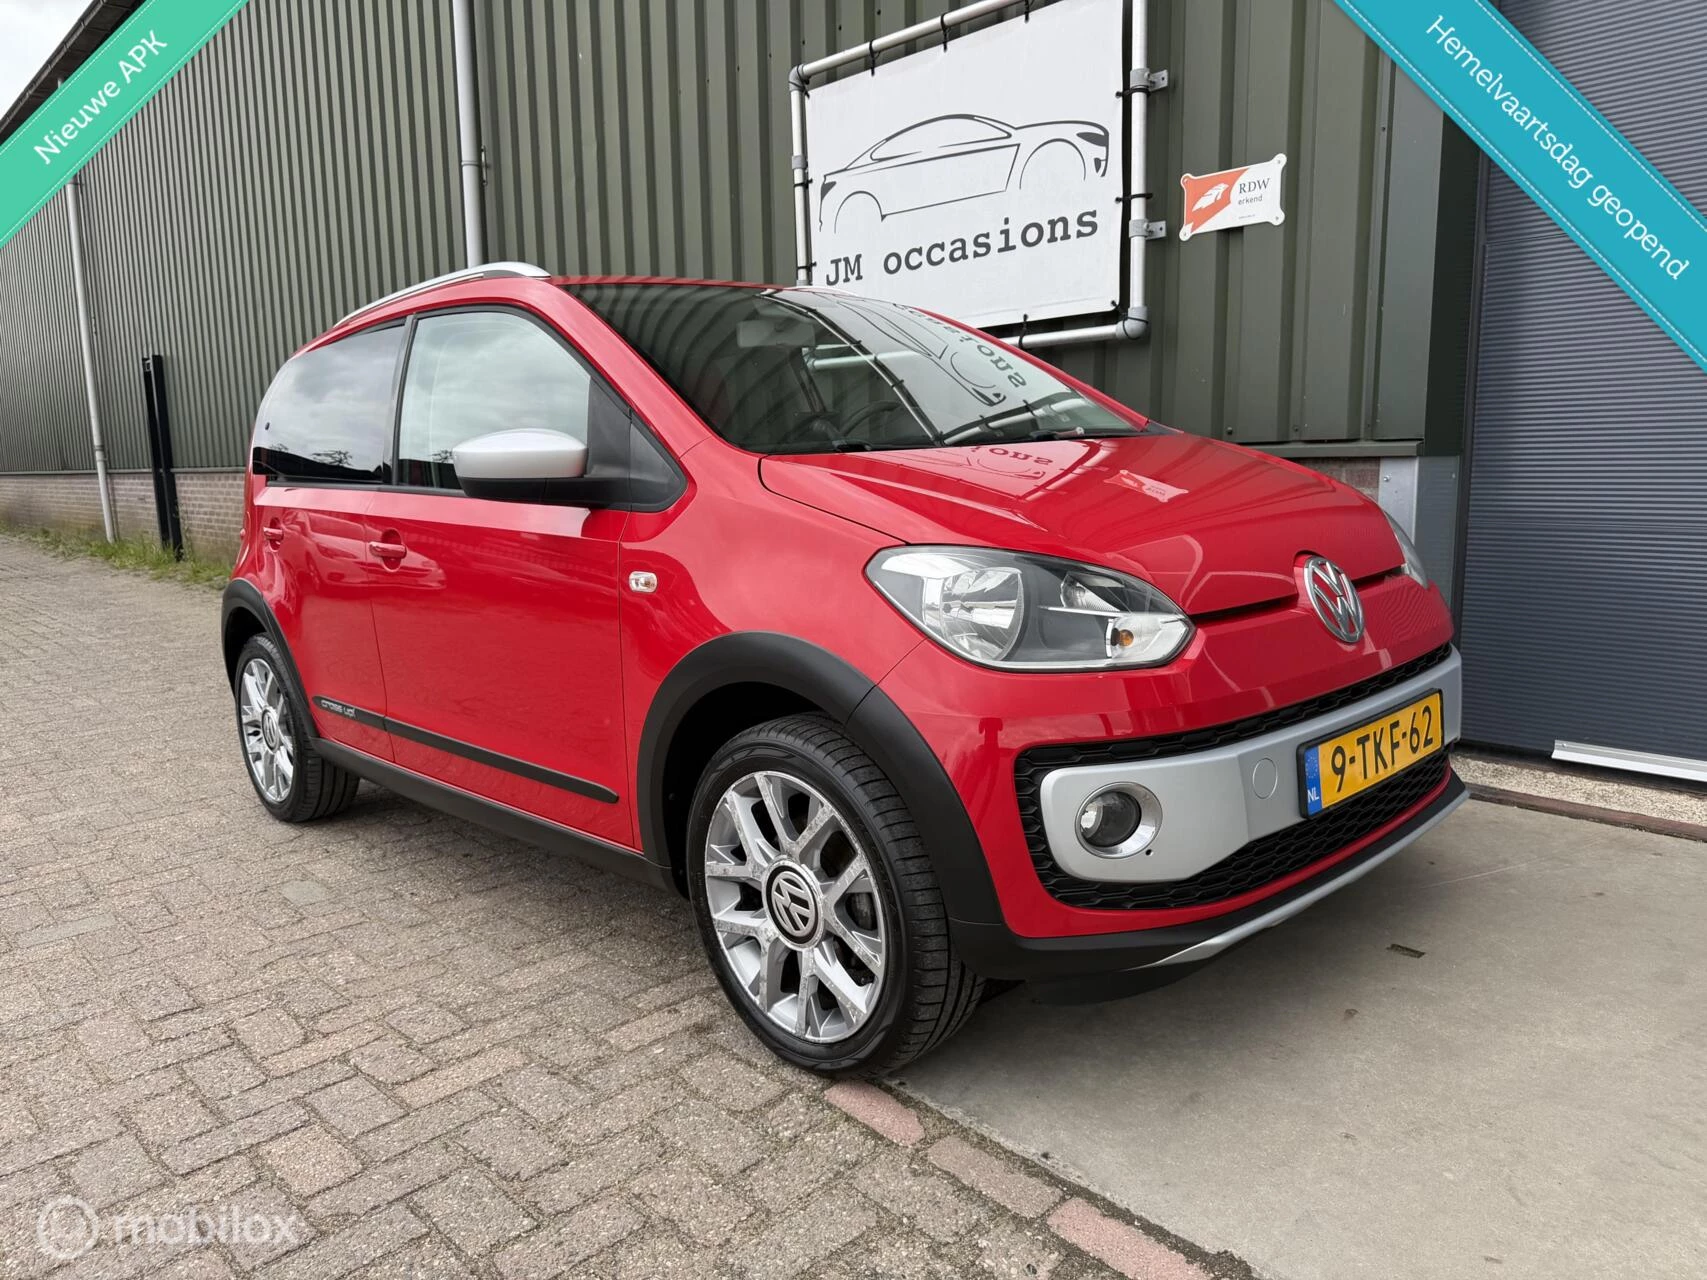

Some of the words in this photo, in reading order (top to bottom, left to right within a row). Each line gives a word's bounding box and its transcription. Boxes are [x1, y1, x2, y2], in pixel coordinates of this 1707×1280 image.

[1237, 195, 1263, 206] erkend
[1238, 177, 1271, 194] RDW
[825, 253, 863, 286] JM
[883, 209, 1098, 275] occasions
[1303, 555, 1364, 643] VW
[1331, 705, 1433, 793] 9-TKF-62
[1307, 787, 1320, 803] NL
